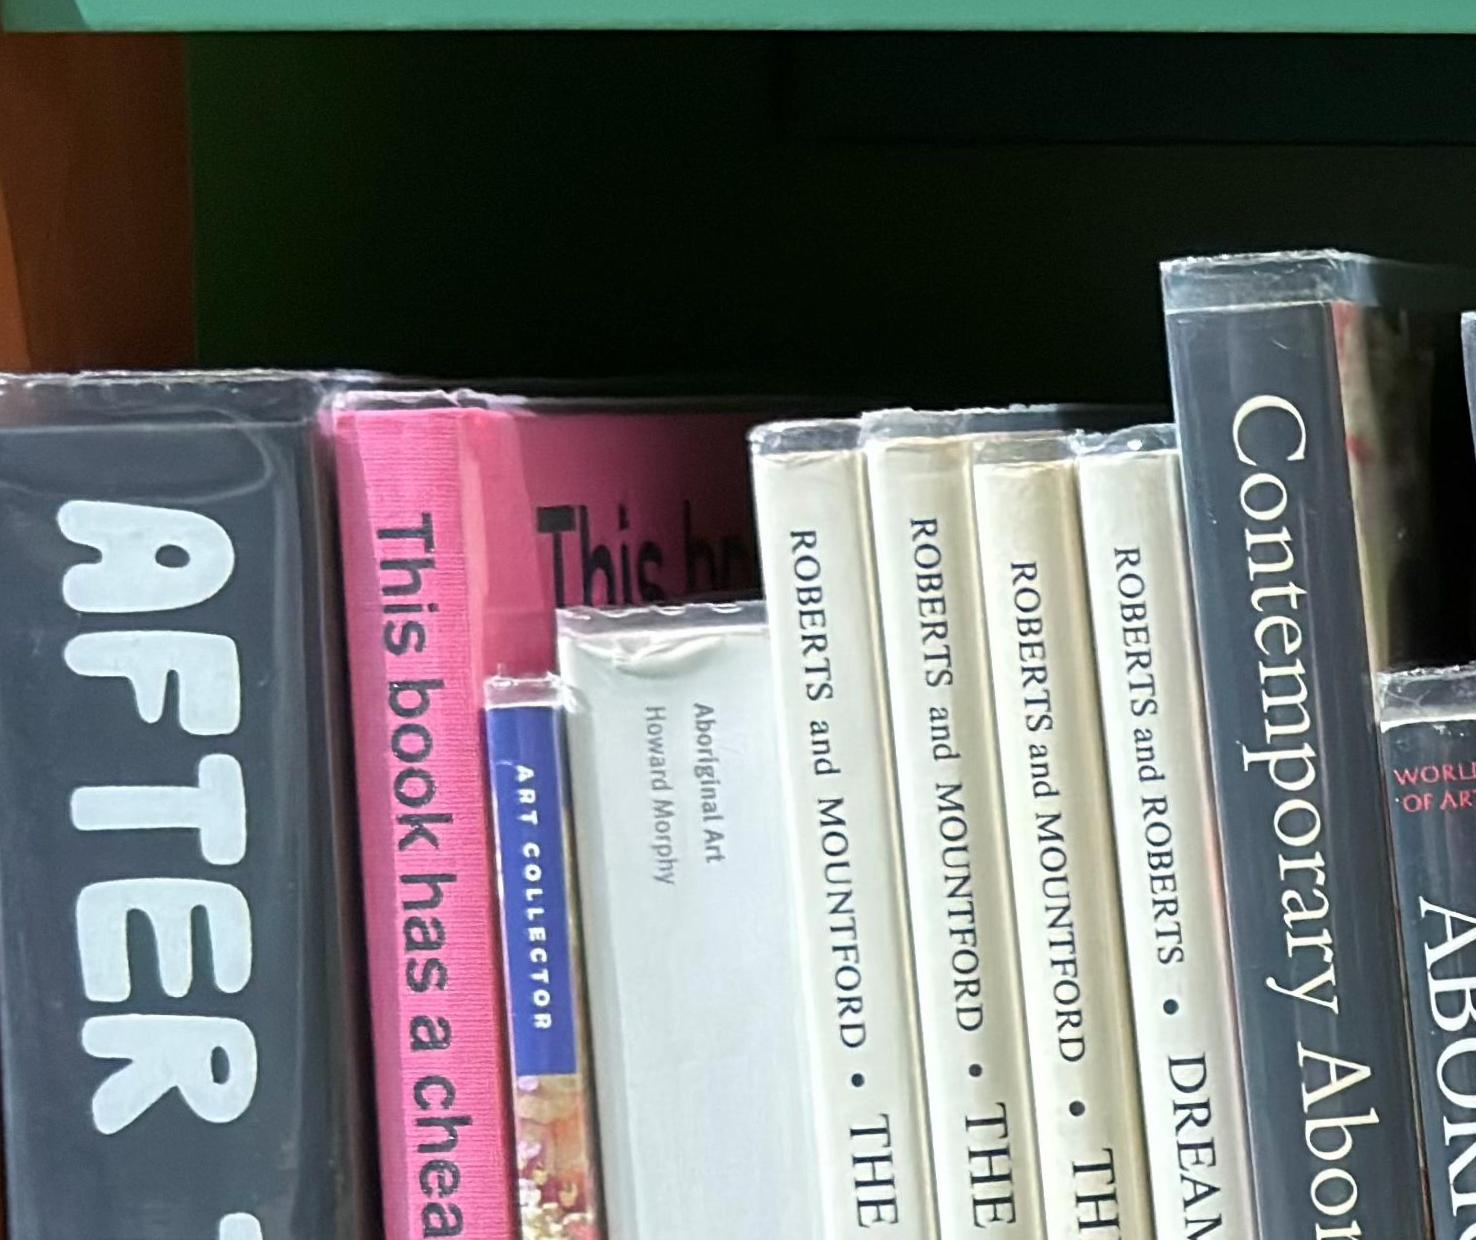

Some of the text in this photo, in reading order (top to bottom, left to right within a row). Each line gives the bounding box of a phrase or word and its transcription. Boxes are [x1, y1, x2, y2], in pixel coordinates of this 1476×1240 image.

[377, 512, 434, 655] This
[536, 504, 666, 607] This
[790, 529, 833, 701] ROBERTS
[911, 517, 954, 687] ROBERTS
[1114, 547, 1158, 716] ROBERTS
[1011, 561, 1053, 733] ROBERTS
[1232, 394, 1339, 1014] Contemporary
[58, 500, 257, 1134] AFTER
[389, 680, 454, 849] book
[645, 706, 680, 886] Howard Morphy
[693, 702, 726, 864] Aboriginal Art
[810, 720, 841, 776] and
[929, 707, 961, 761] and
[1029, 745, 1061, 798] and
[1134, 728, 1165, 782] and
[1402, 793, 1435, 814] OF
[400, 872, 455, 995] has
[515, 765, 552, 1031] ART COLLECTOR
[818, 797, 867, 1048] MOUNTFORD
[936, 782, 984, 1031] MOUNTFORD
[1036, 812, 1085, 1062] MOUNTFORD
[1142, 796, 1184, 965] ROBERTS
[411, 1014, 451, 1052] a
[850, 1113, 898, 1229] THE
[965, 1102, 1016, 1229] THE
